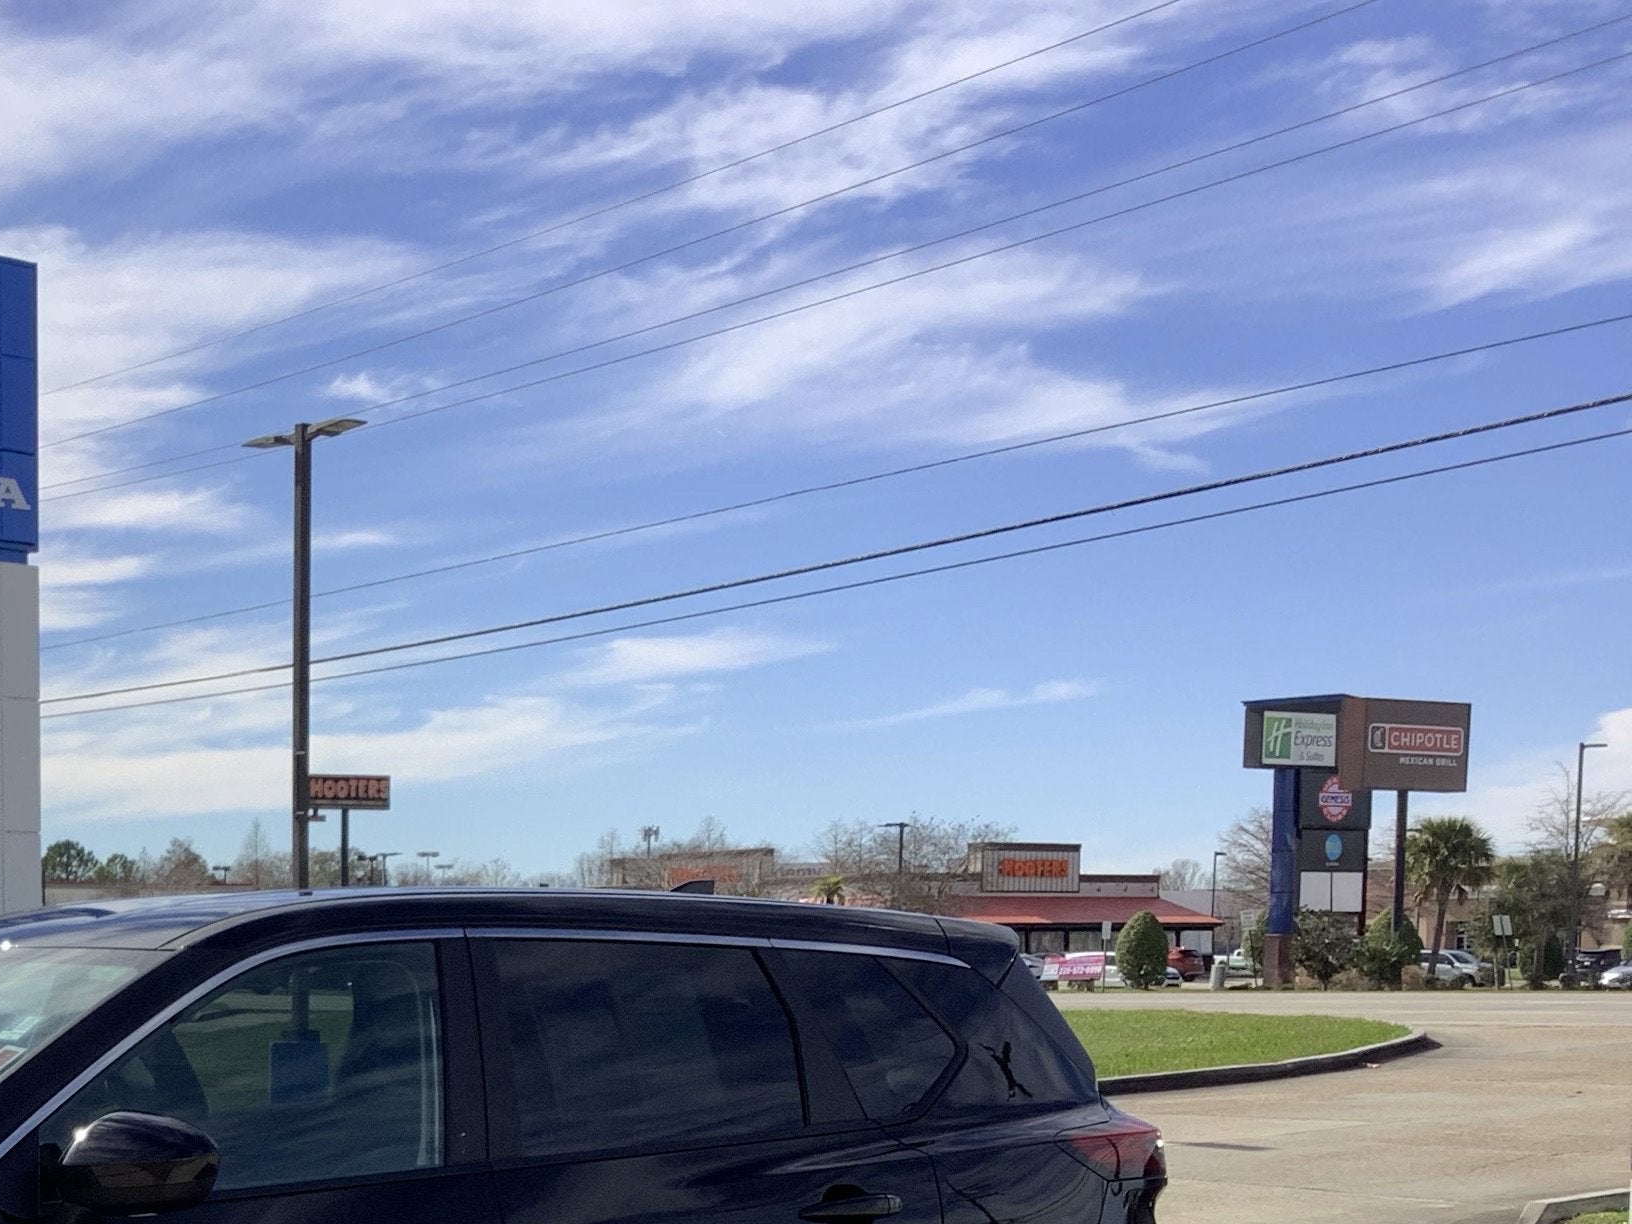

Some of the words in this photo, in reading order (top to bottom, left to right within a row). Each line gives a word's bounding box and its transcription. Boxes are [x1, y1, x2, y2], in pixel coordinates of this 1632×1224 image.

[1294, 730, 1333, 749] Express
[1390, 731, 1460, 749] CHIPOTLE
[1399, 756, 1434, 766] MEXICAN
[1435, 757, 1458, 767] GRILL
[310, 778, 388, 799] HOOTERS
[1001, 857, 1069, 877] HOOTERS
